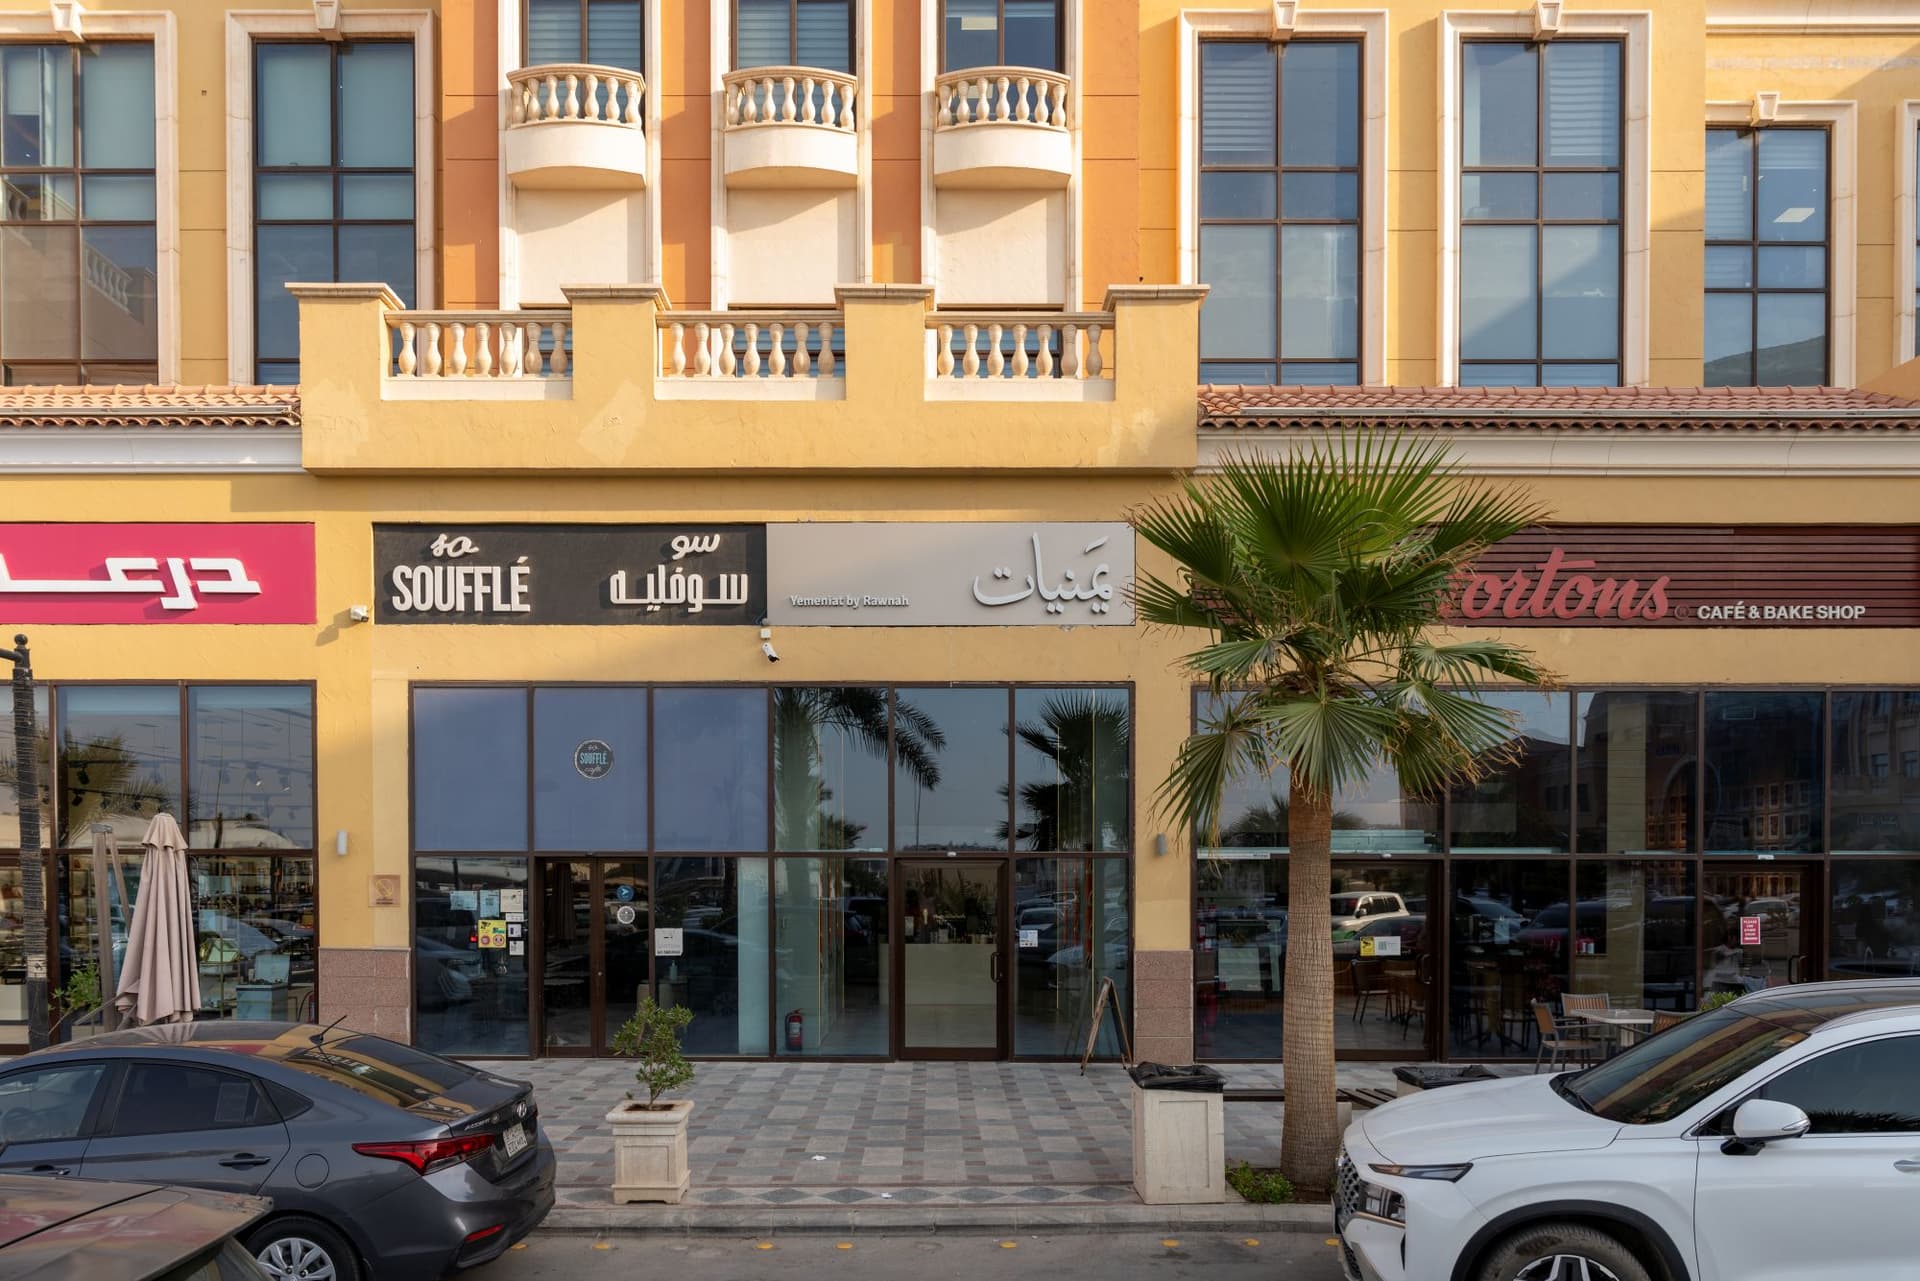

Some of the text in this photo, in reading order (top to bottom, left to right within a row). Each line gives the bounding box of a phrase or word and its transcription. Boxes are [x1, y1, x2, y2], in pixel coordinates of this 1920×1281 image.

[392, 556, 531, 612] SOUFFLÉ
[790, 595, 909, 610] Yemeniat by Rawnah
[1697, 601, 1866, 619] CAFÉ & BAKE SHOP
